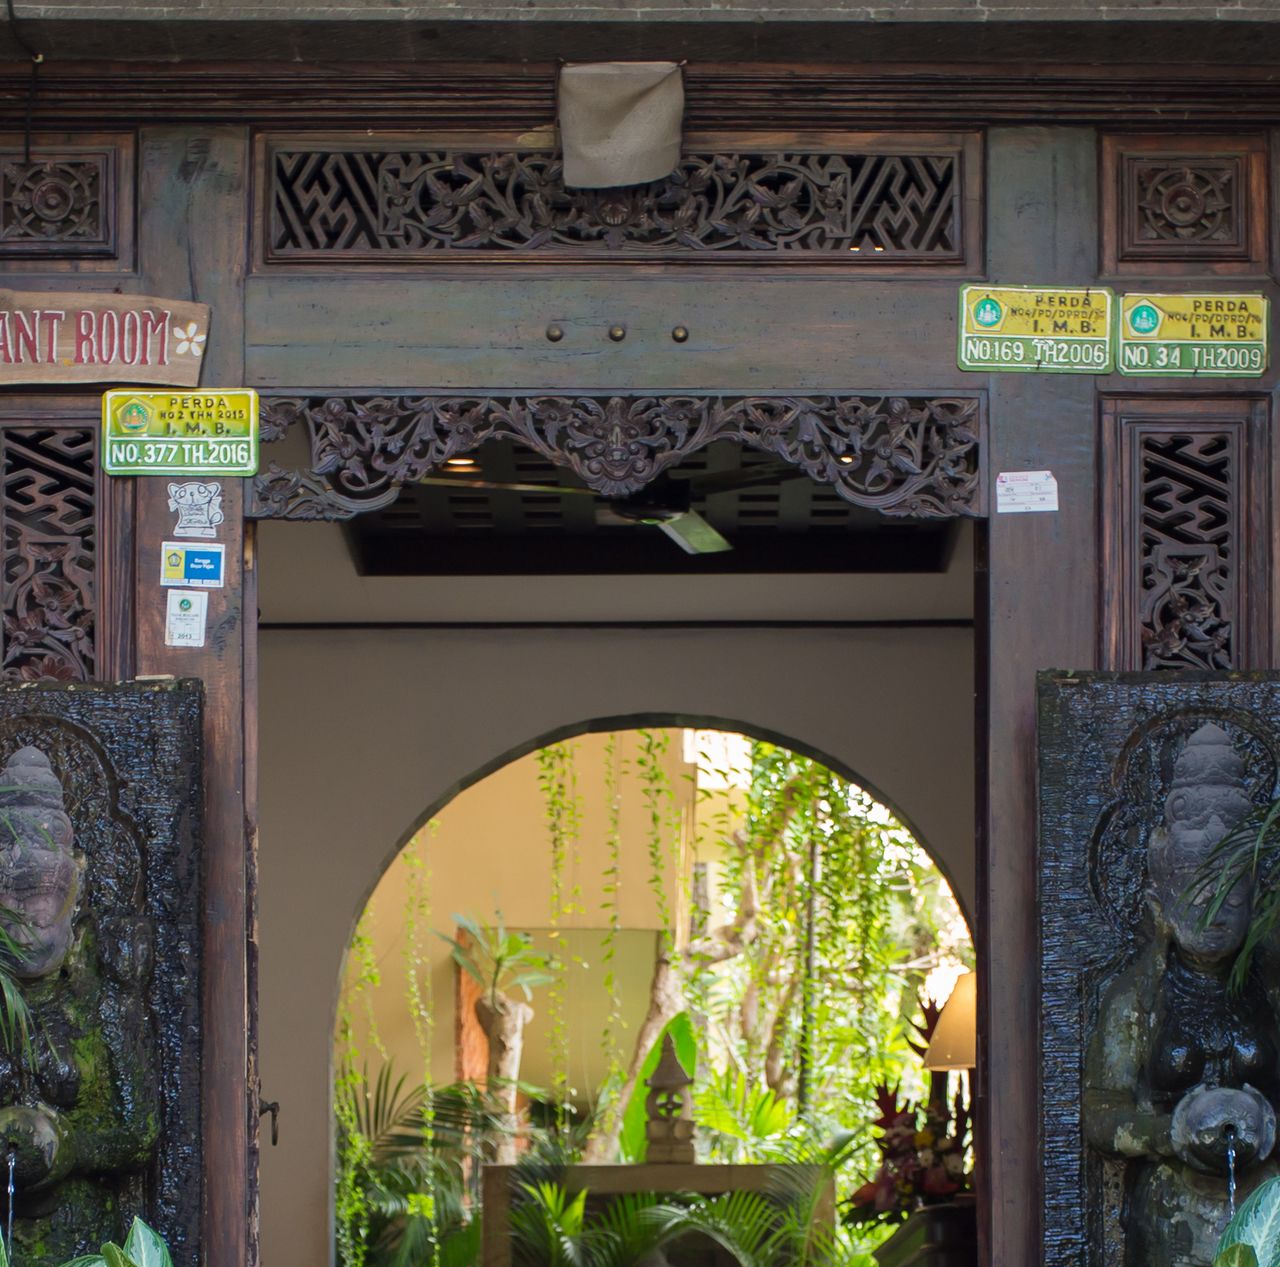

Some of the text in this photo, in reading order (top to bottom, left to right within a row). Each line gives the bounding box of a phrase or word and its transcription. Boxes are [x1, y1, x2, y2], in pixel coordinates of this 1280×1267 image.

[1035, 296, 1092, 307] PERDA
[1193, 300, 1249, 312] PERDA
[74, 309, 171, 365] ROOM
[1156, 347, 1181, 367] 34
[170, 398, 227, 408] PERDA
[218, 410, 244, 419] 2015
